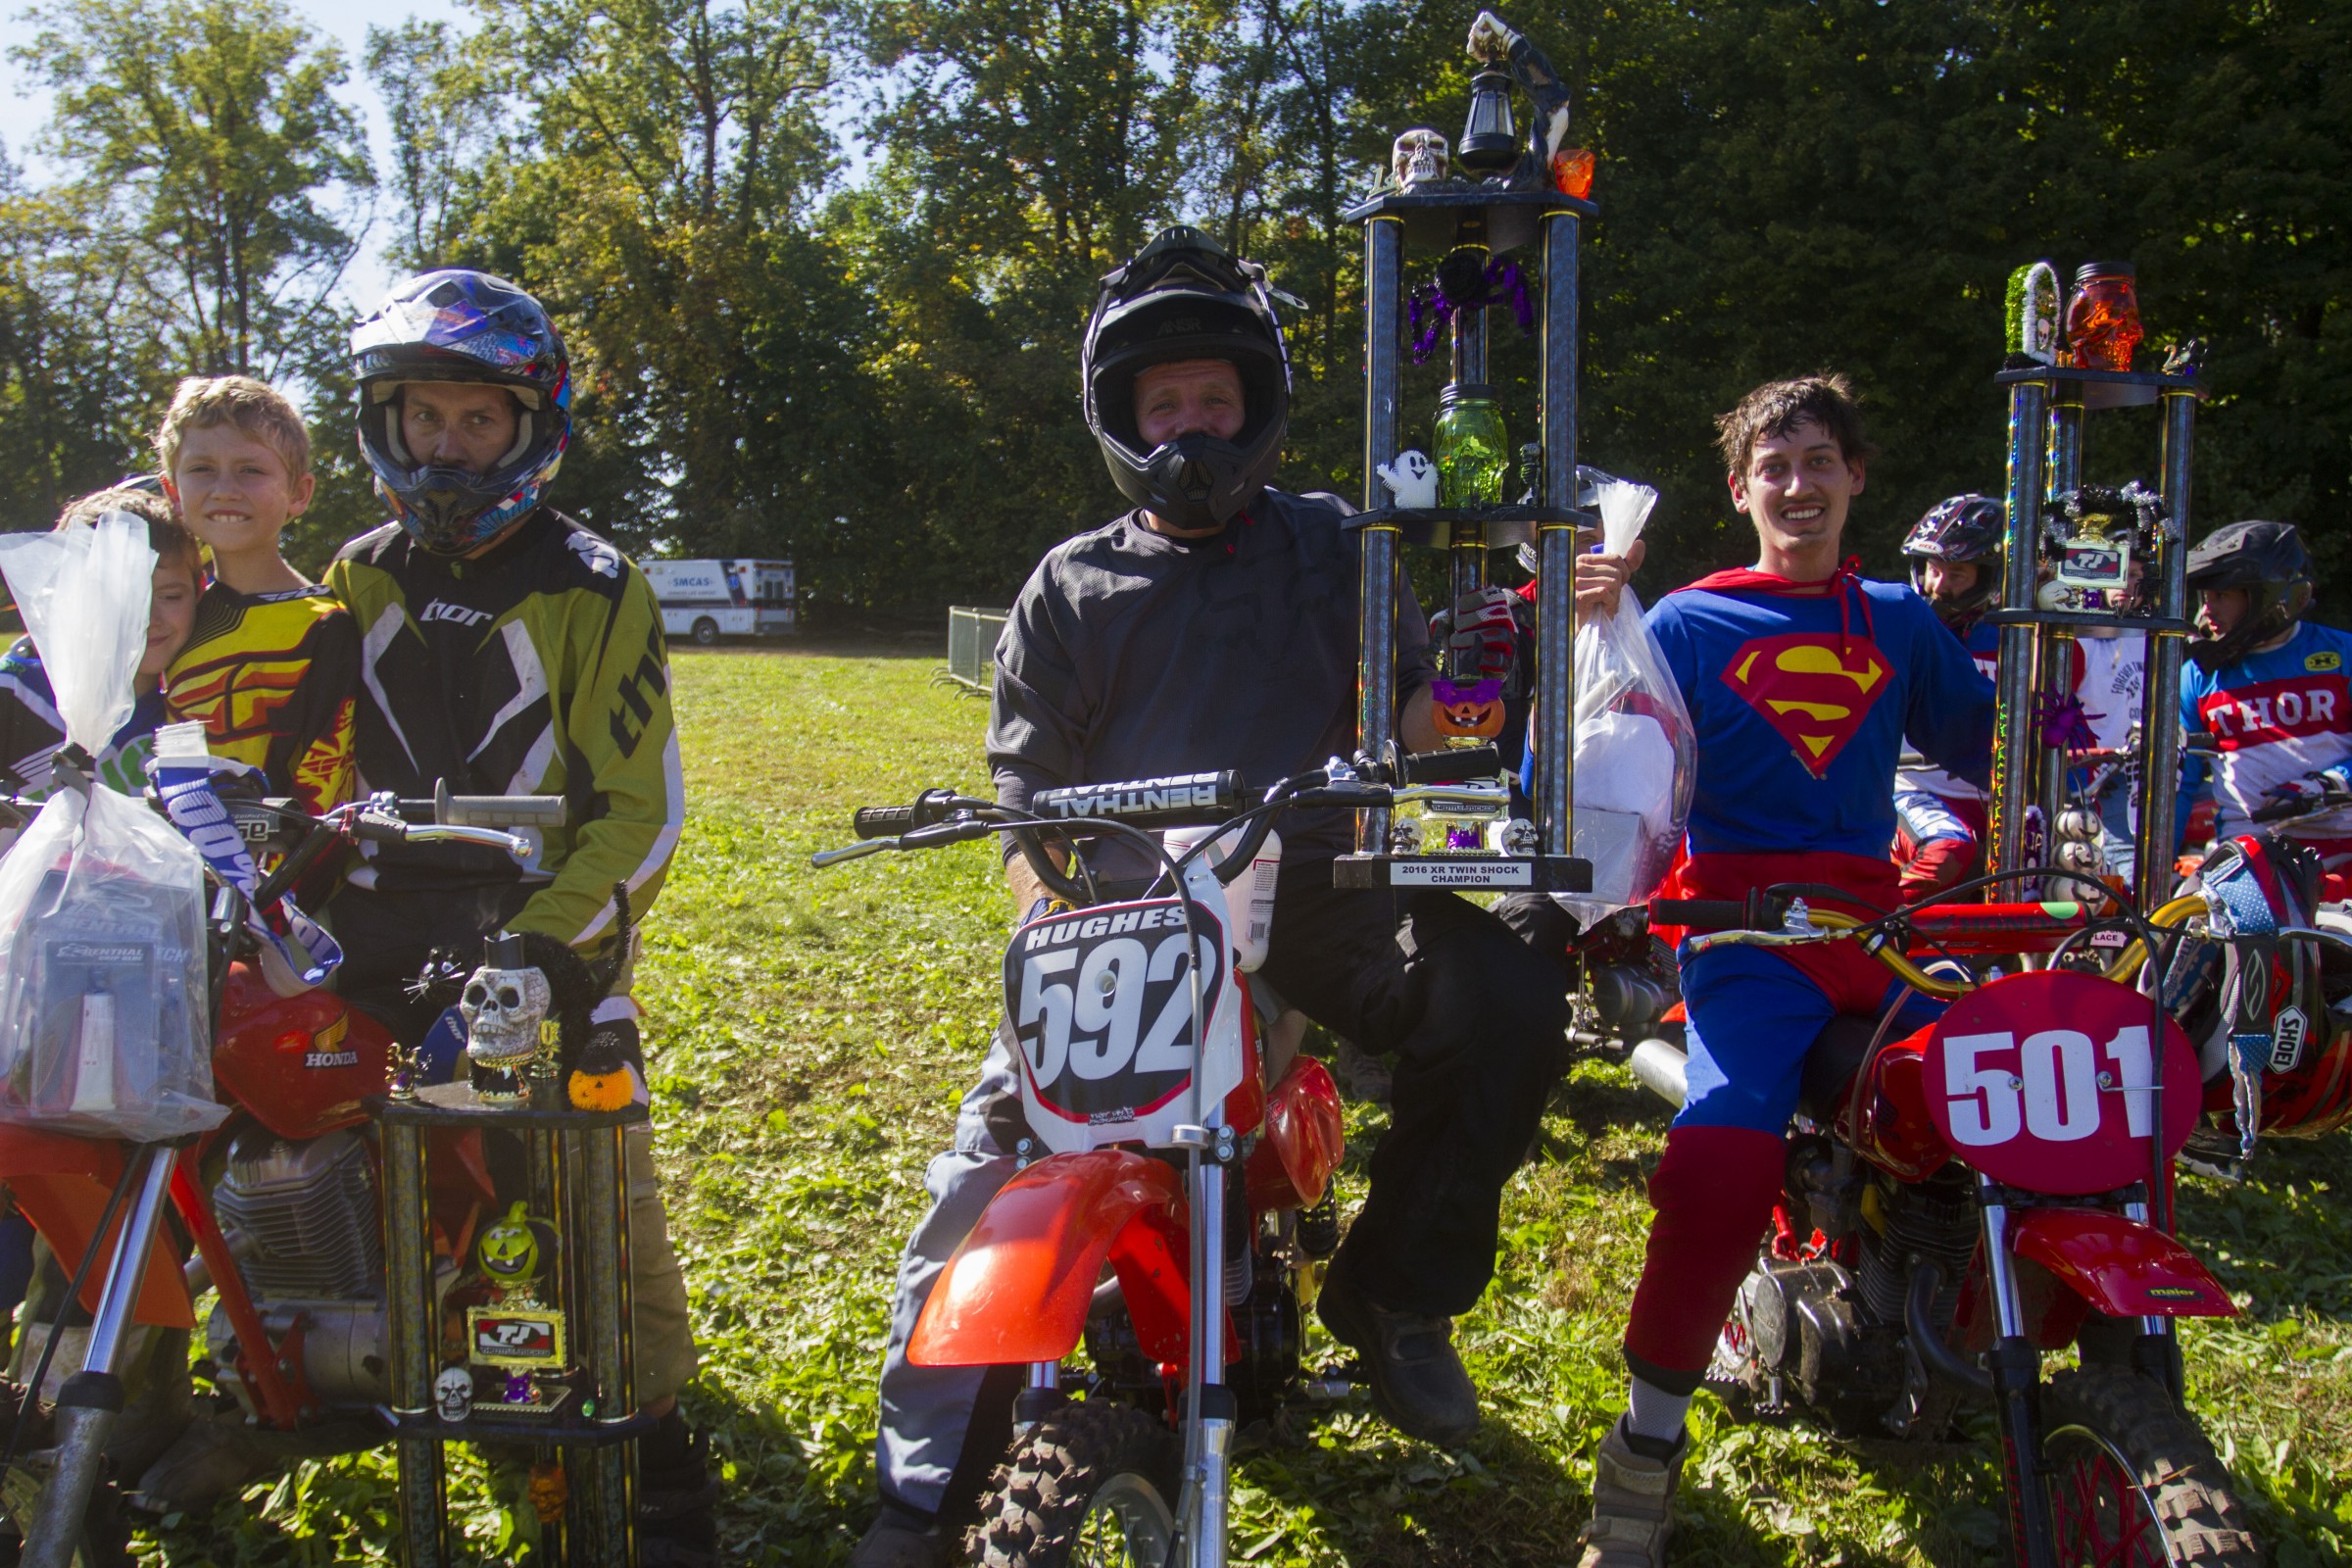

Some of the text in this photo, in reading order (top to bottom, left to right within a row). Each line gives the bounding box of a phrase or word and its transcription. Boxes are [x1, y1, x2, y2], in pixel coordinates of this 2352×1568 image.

[672, 576, 710, 587] SMCAS
[2206, 689, 2335, 737] THOR
[1050, 784, 1217, 818] RENTHAL
[1401, 865, 1428, 874] 2016
[1480, 865, 1520, 874] SHOCK
[1024, 906, 1189, 953] HUGHES
[1017, 932, 1217, 1089] 592
[2273, 1017, 2300, 1066] SHOEI
[305, 1051, 359, 1067] HONDA
[1942, 1025, 2154, 1147] 501
[2149, 1288, 2195, 1297] maier
[497, 1324, 531, 1345] TJ
